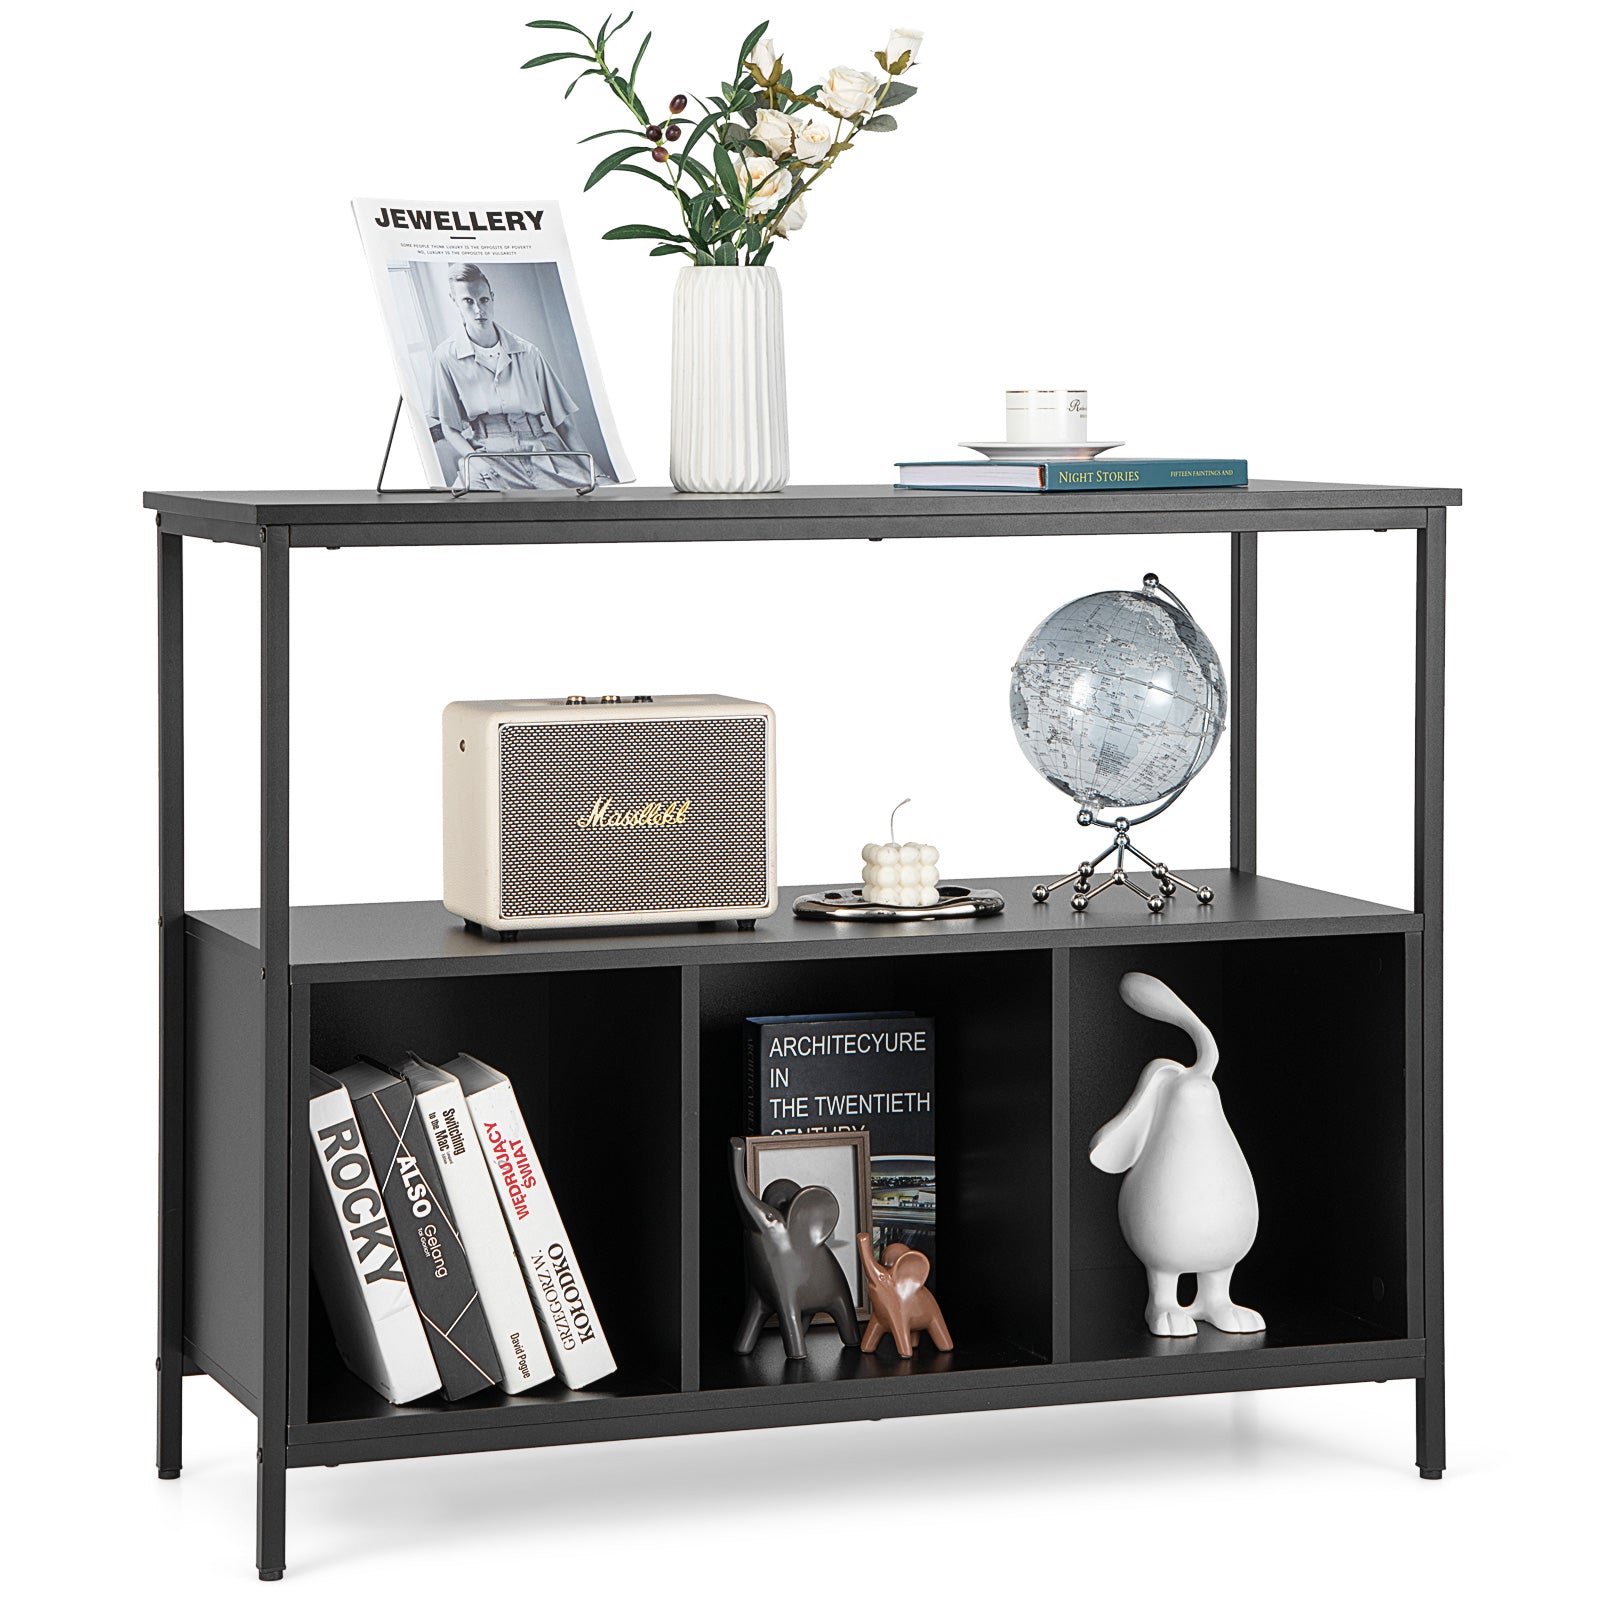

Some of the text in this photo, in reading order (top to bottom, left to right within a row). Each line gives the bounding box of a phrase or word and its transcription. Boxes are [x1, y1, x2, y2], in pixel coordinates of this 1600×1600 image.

[375, 207, 544, 231] JEWELLERY
[1170, 470, 1192, 478] FIFTEEN
[768, 1031, 927, 1058] ARCHITECYURE
[770, 1067, 789, 1089] IN
[428, 1111, 437, 1120] to
[431, 1119, 440, 1131] the
[769, 1092, 931, 1119] THE TWENTIETH
[434, 1129, 450, 1152] Mac
[442, 1108, 466, 1156] Switching
[396, 1156, 432, 1218] ALSO
[483, 1122, 529, 1221] WĘDRUJĄCY
[508, 1139, 537, 1189] ŚWIAT
[317, 1117, 406, 1285] ROCKY
[424, 1224, 448, 1278] Gelang
[530, 1249, 577, 1351] GRZEGORZ W.
[547, 1242, 596, 1345] KOŁODKO
[510, 1332, 531, 1379] David Pogue
